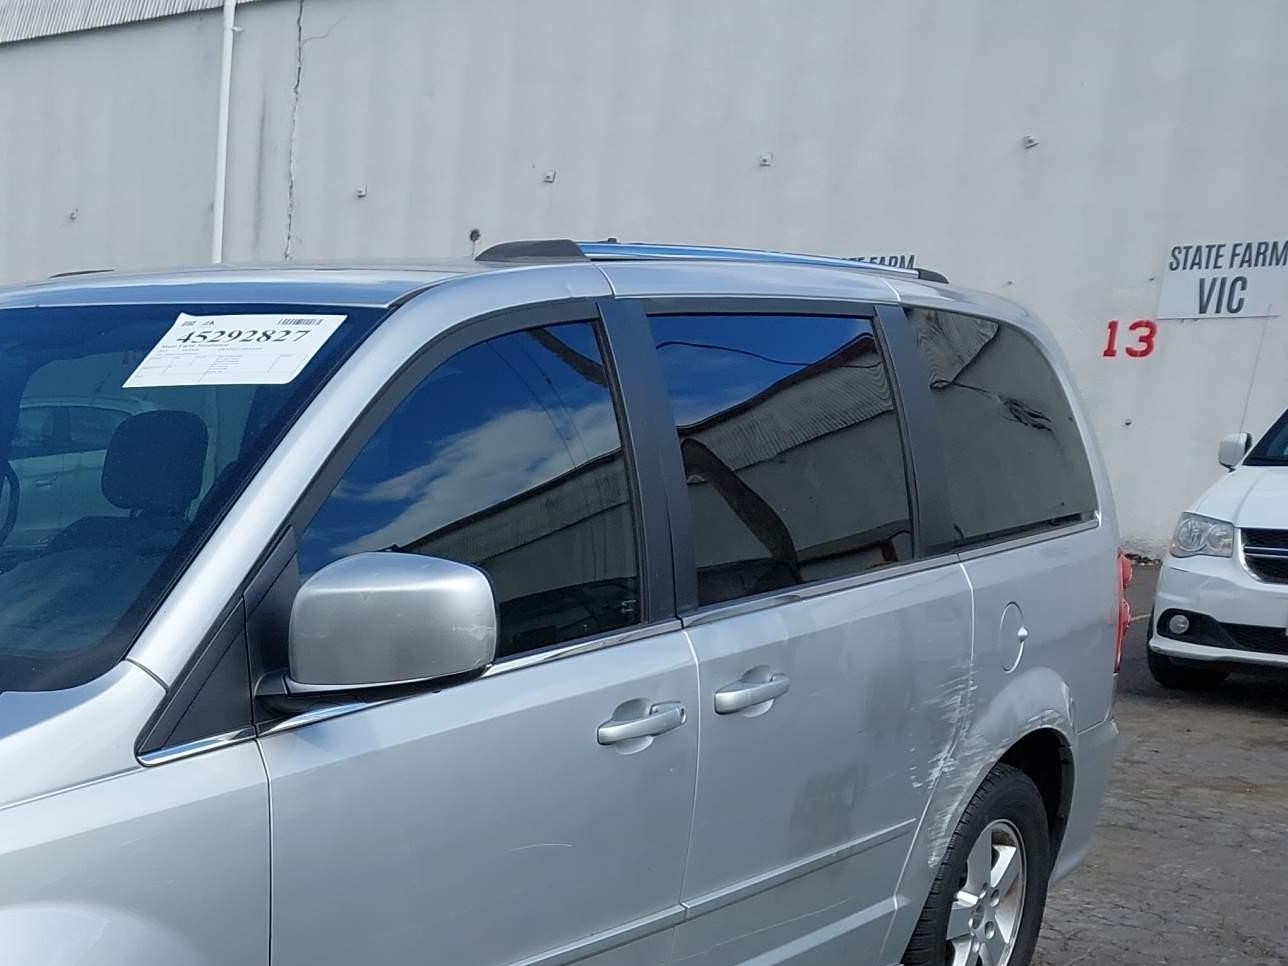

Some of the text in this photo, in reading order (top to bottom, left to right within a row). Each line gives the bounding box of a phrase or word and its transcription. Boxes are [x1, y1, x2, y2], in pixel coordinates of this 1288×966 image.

[1169, 240, 1288, 271] STATE FARM
[1198, 275, 1248, 315] VIC
[176, 329, 312, 344] 45292827
[1102, 319, 1158, 358] 13
